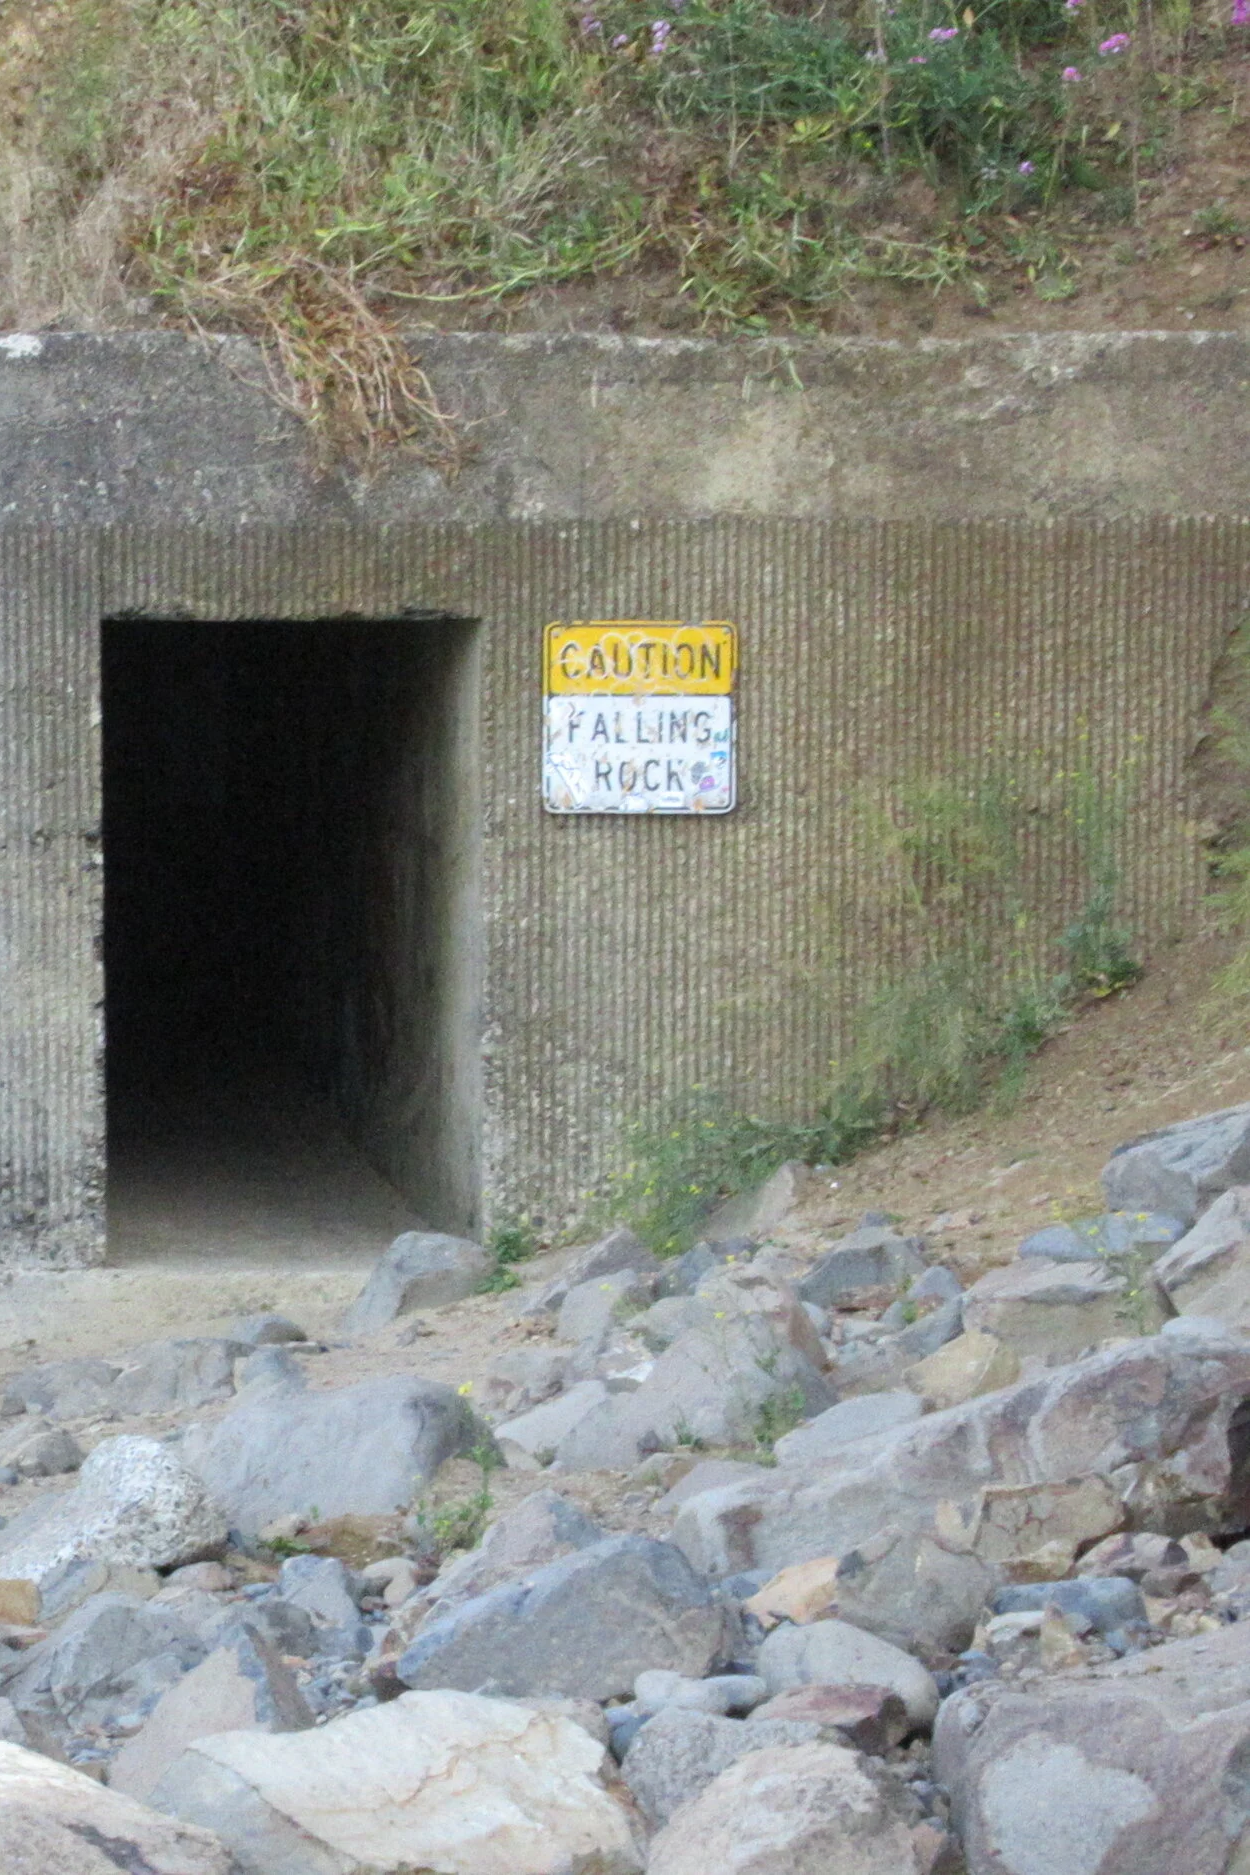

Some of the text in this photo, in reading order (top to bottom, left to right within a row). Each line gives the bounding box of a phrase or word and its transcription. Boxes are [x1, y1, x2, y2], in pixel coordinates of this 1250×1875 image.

[560, 642, 721, 679] CAUTION
[568, 710, 713, 744] FALLING
[594, 759, 685, 792] ROCK
